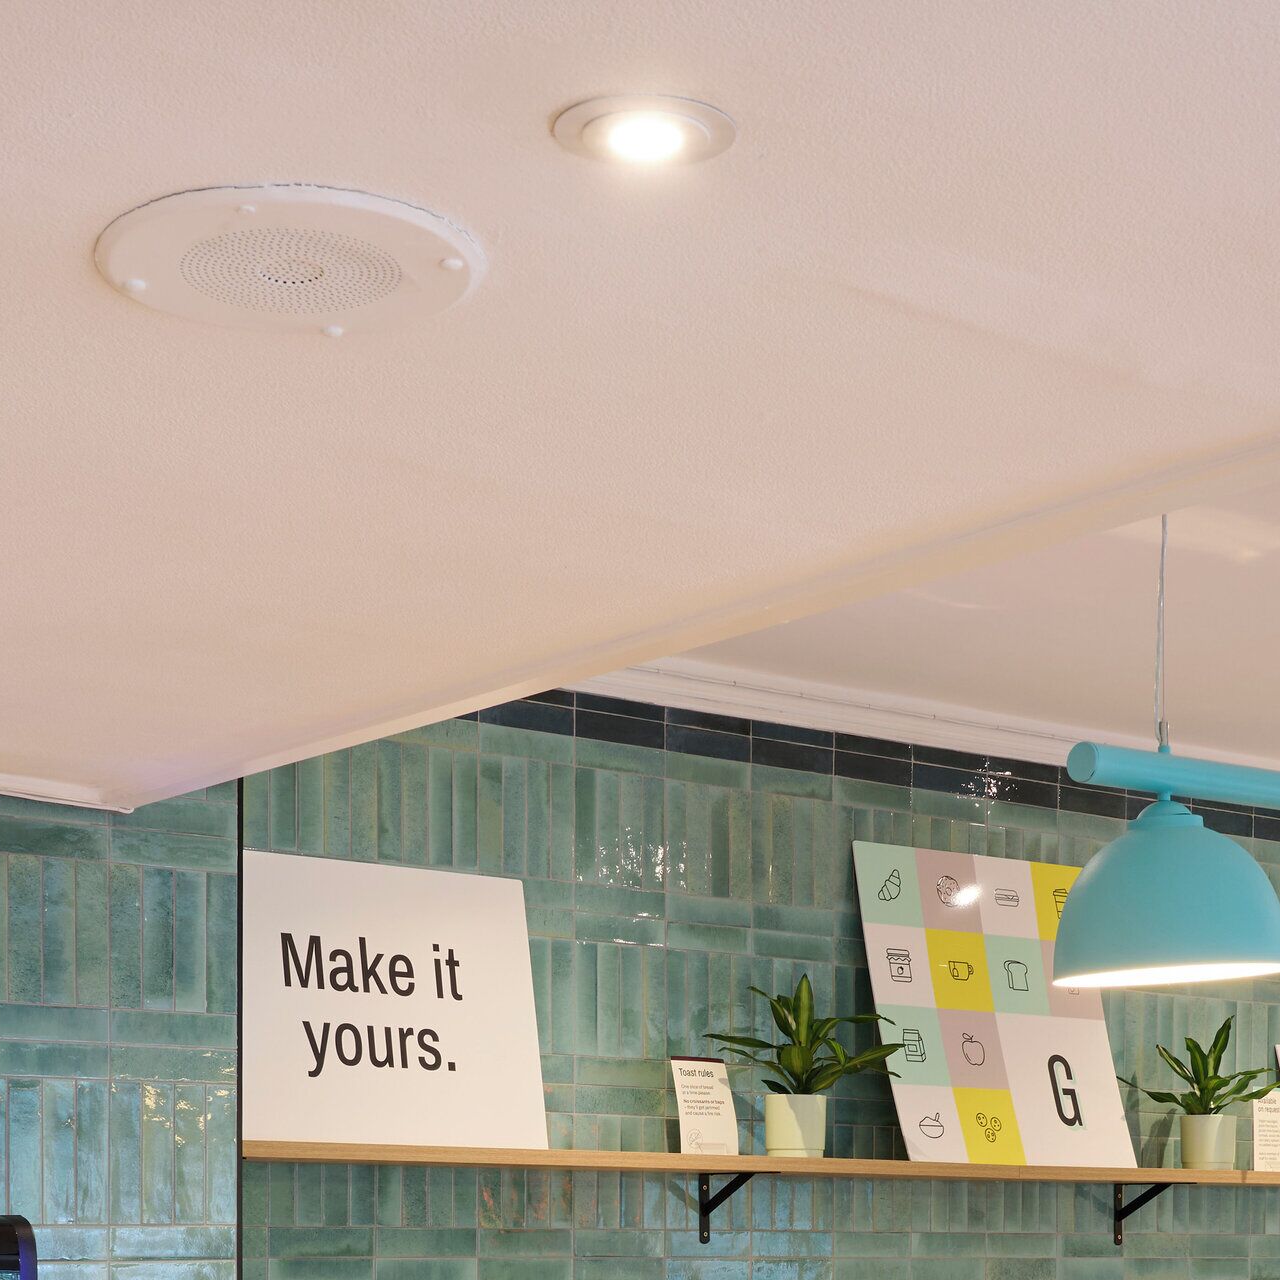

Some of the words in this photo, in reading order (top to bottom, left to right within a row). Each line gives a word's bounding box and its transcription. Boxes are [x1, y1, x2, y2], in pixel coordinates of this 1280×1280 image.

[280, 932, 415, 998] Make
[432, 943, 463, 1001] it
[301, 1020, 456, 1078] yours.
[678, 1068, 697, 1077] Toast
[698, 1068, 714, 1078] rules
[1047, 1054, 1083, 1127] G
